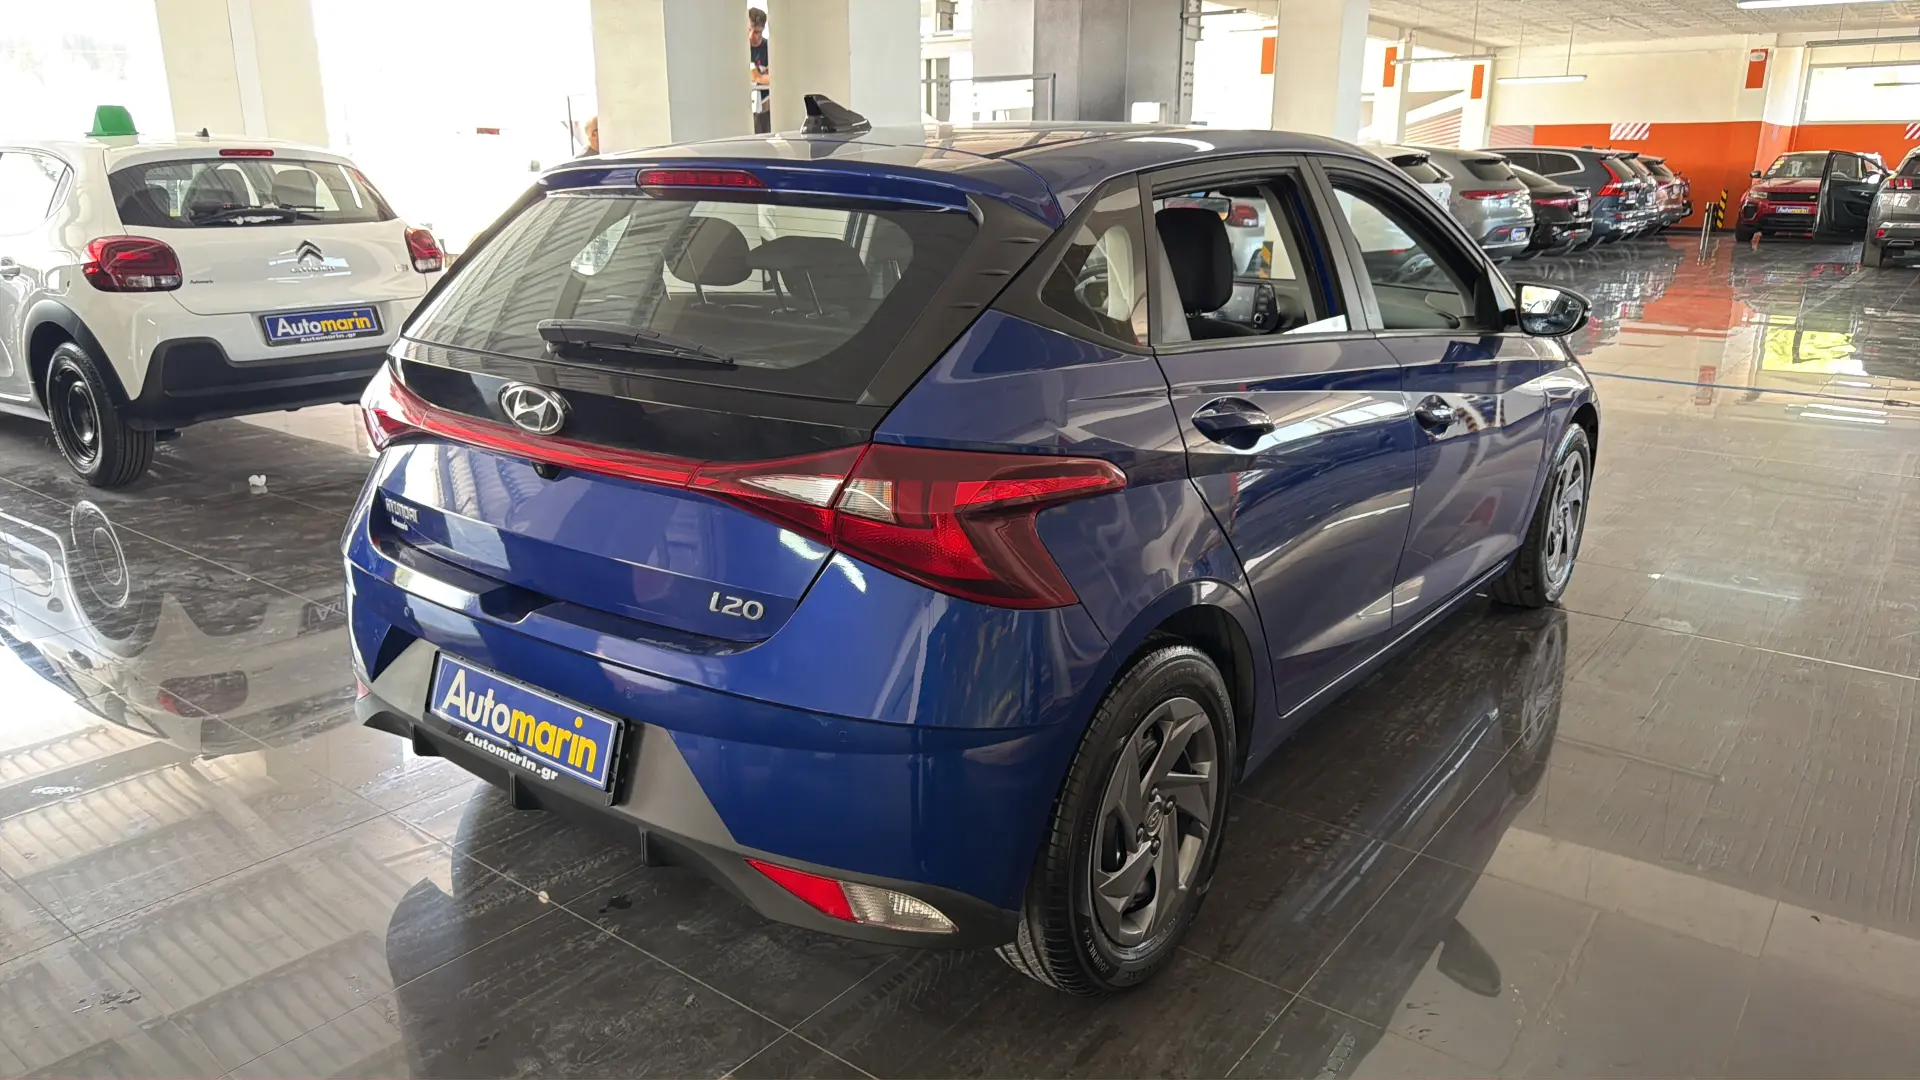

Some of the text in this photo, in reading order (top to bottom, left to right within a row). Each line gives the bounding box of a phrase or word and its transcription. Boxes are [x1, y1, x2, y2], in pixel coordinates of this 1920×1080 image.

[276, 312, 371, 337] Automarin
[300, 333, 357, 343] Automarin.gr
[385, 497, 419, 524] HYUNDAI
[441, 668, 597, 773] Automarin
[464, 731, 559, 781] Automarin.gr
